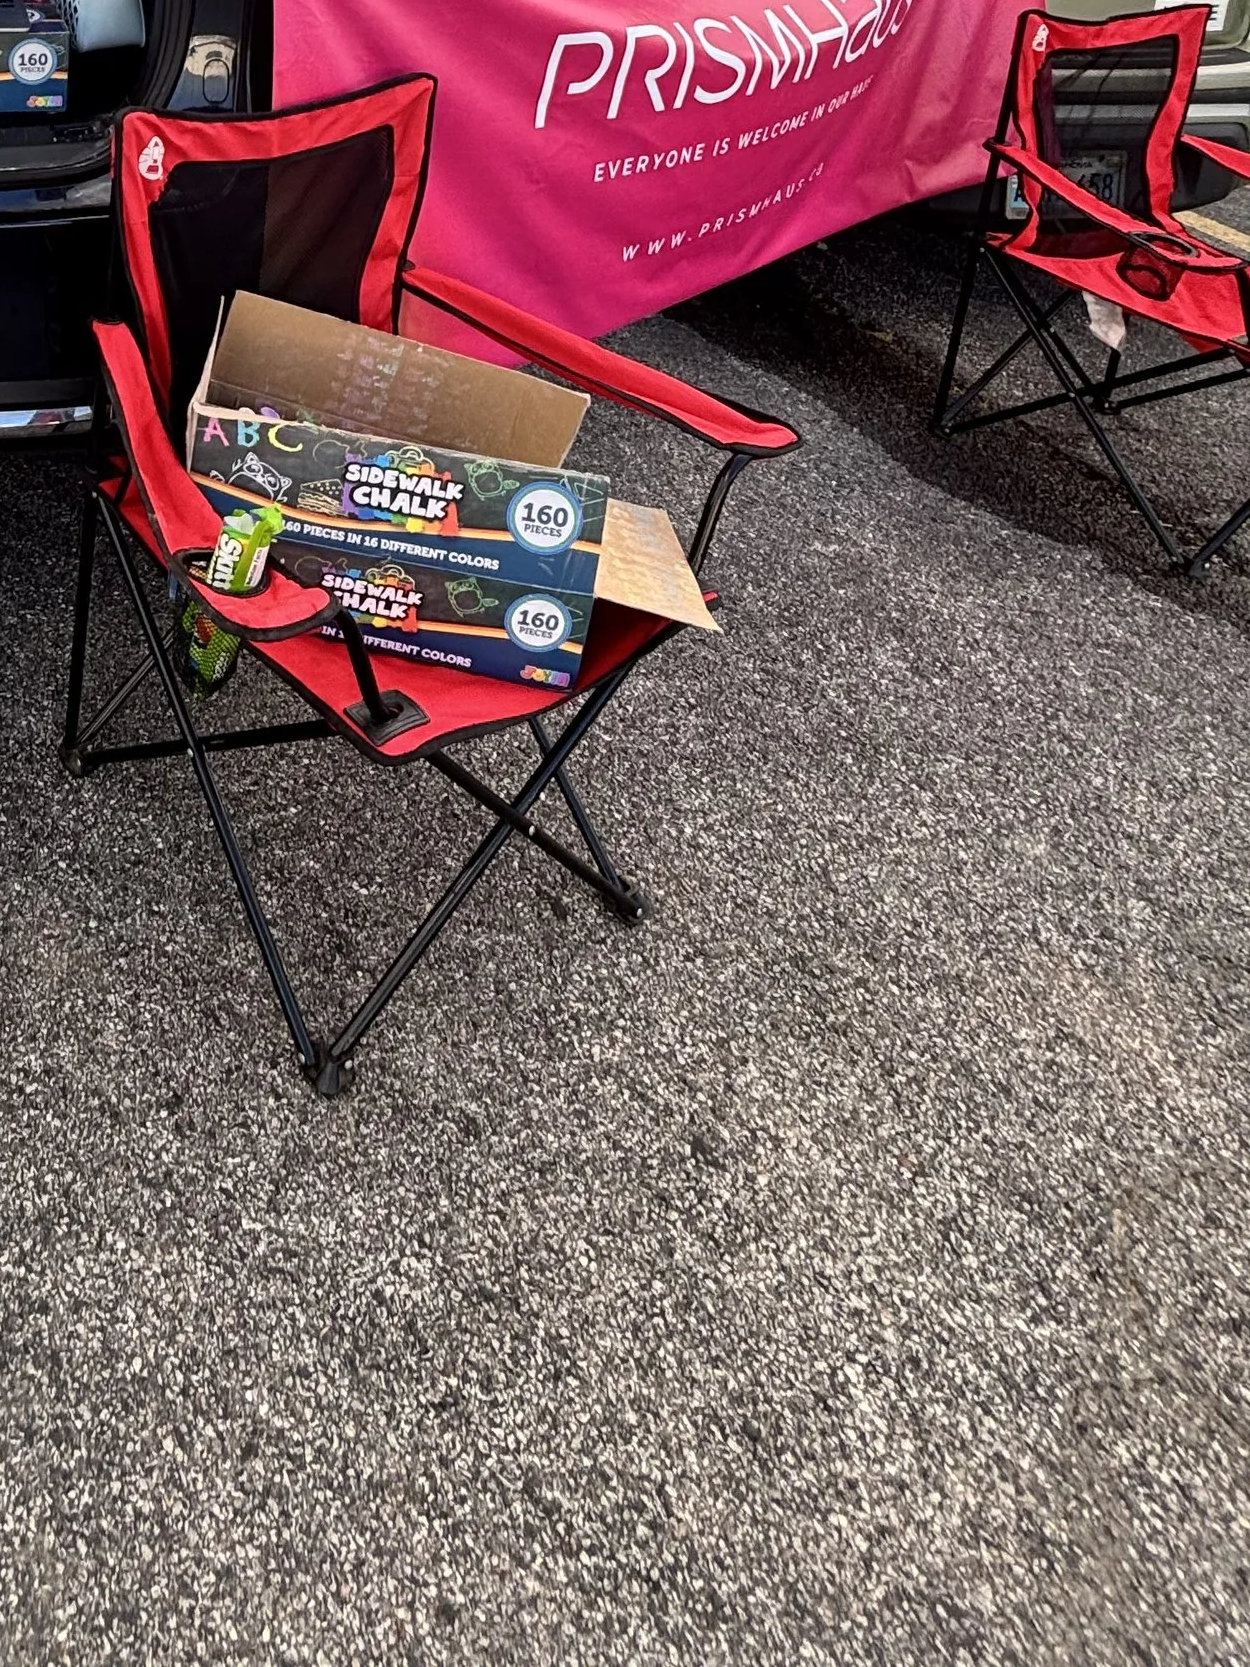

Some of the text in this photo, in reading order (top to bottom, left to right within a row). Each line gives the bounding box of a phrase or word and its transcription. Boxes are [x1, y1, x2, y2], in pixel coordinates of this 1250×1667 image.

[18, 53, 48, 66] 160
[593, 142, 706, 183] EVERYONE
[712, 137, 731, 157] IS
[737, 111, 809, 150] WELCOME
[811, 103, 826, 122] IN
[345, 464, 464, 500] SIDEWALK
[352, 486, 449, 519] CHALK
[521, 502, 569, 528] 160
[523, 523, 563, 538] PIECES
[302, 523, 346, 541] PIECES
[347, 533, 363, 545] IN
[364, 535, 379, 548] 16
[380, 539, 448, 562] DIFFERENT
[449, 551, 500, 571] COLORS
[321, 574, 424, 606] SIDEWALK
[517, 609, 559, 631] 160
[519, 625, 553, 639] PIECES
[321, 625, 337, 637] IN
[362, 635, 421, 656] IFFERENT
[421, 648, 473, 668] COLORS
